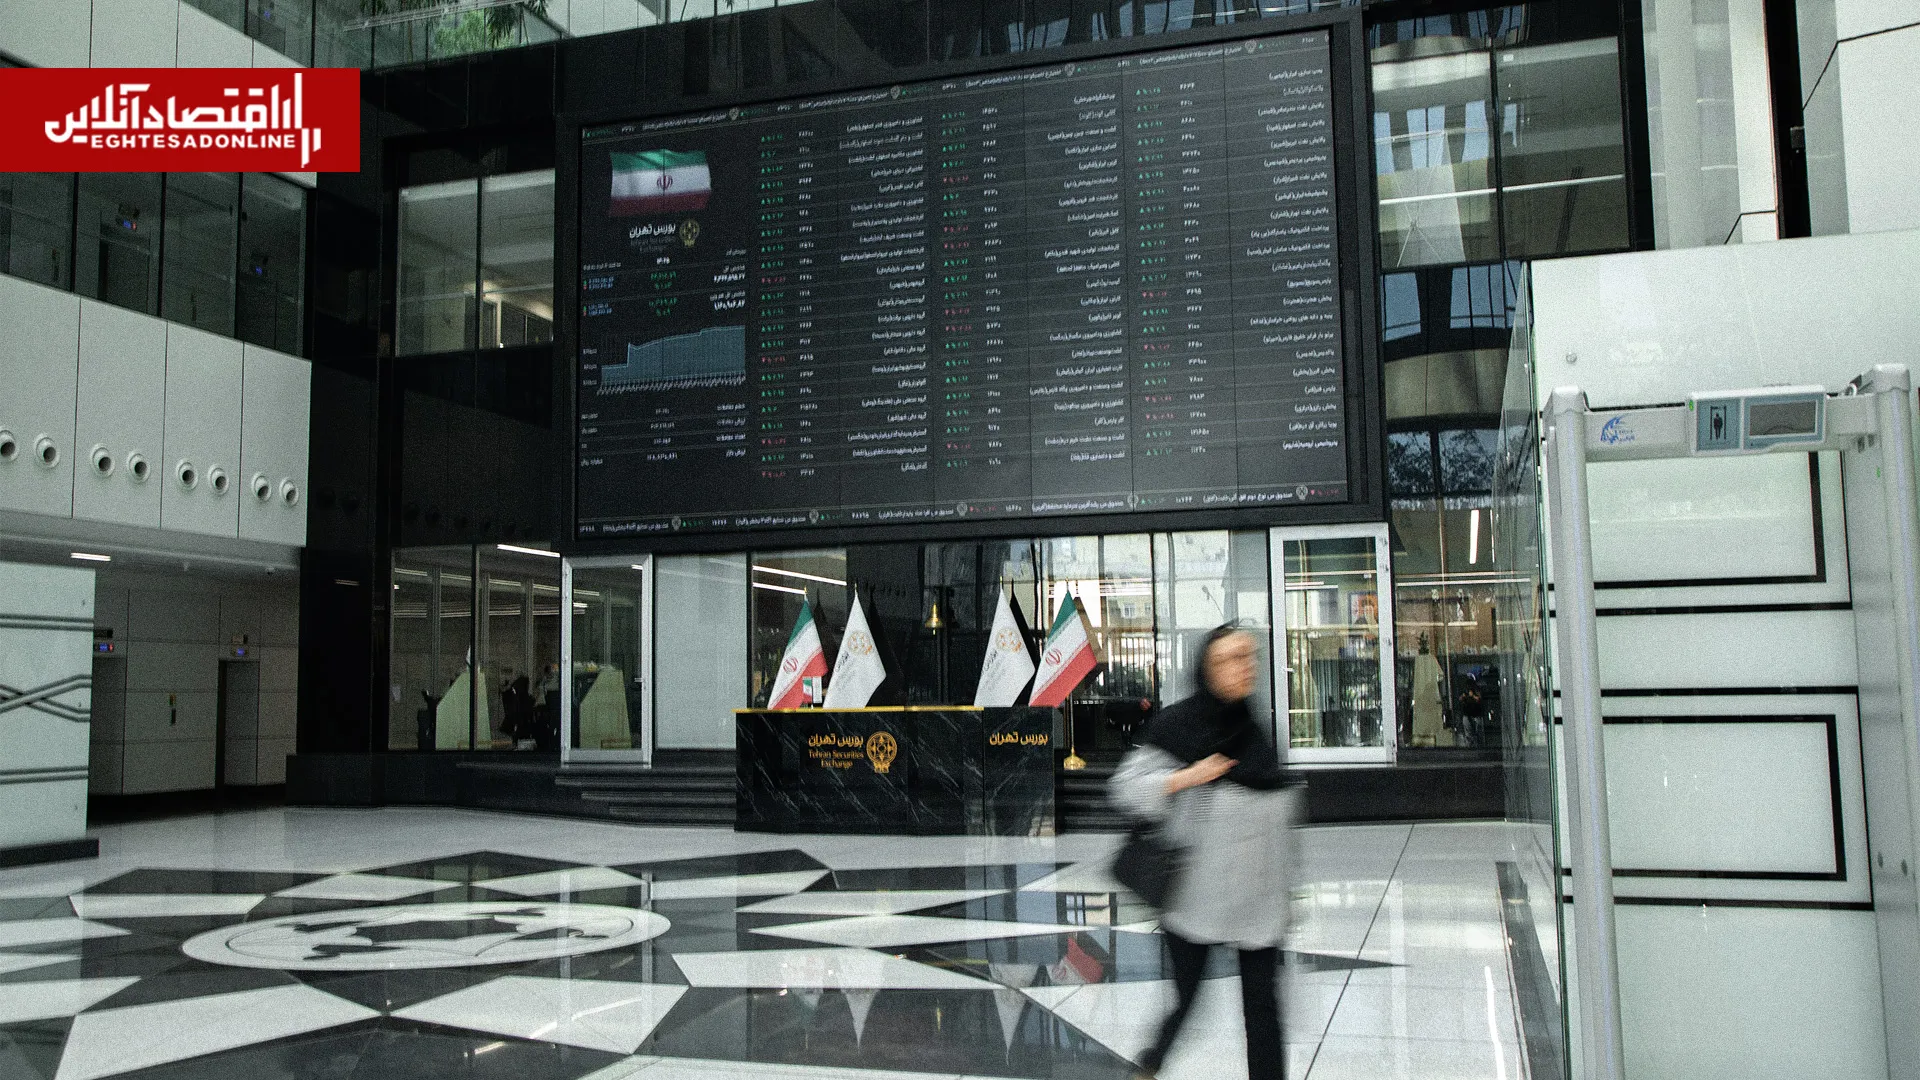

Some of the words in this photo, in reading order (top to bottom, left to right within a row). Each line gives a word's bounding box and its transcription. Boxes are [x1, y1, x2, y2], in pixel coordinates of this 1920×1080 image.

[808, 733, 836, 747] تهران
[837, 735, 864, 748] بورس
[989, 732, 1019, 747] تهران
[1020, 734, 1048, 746] بورس
[809, 750, 831, 759] Tehran
[832, 750, 864, 759] Securities
[821, 760, 853, 769] Exchange
